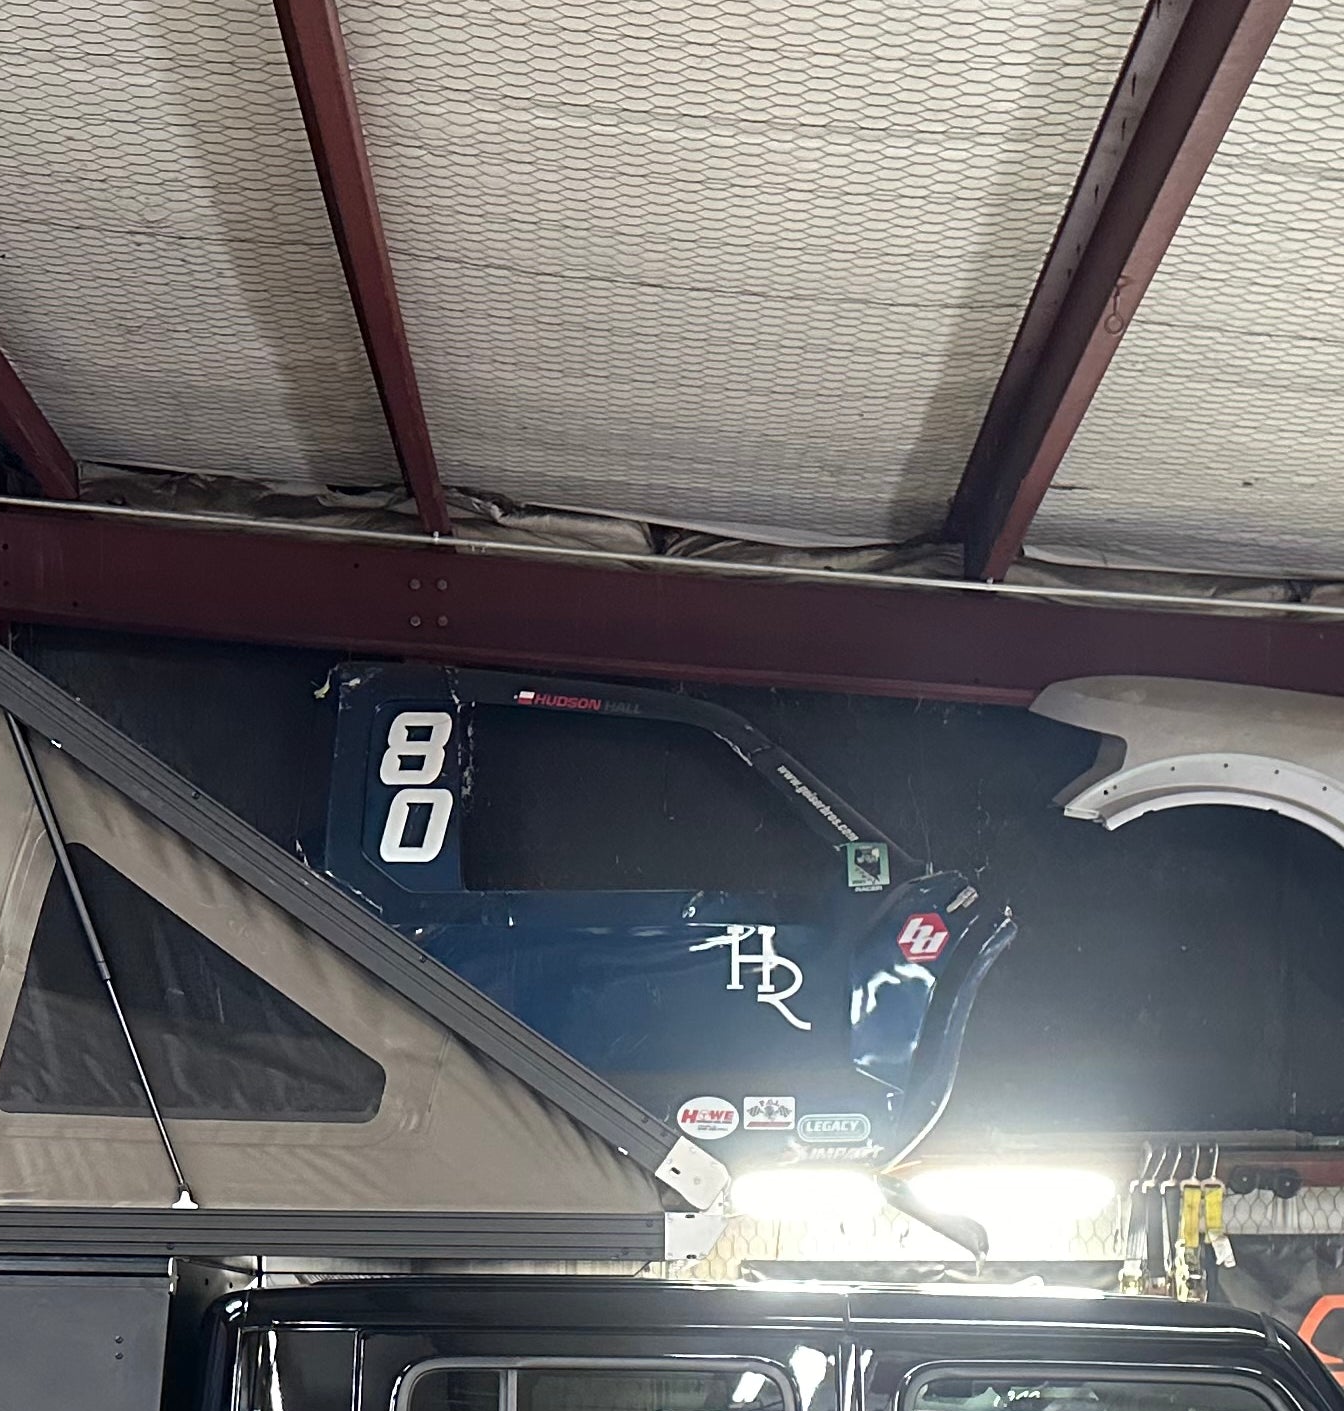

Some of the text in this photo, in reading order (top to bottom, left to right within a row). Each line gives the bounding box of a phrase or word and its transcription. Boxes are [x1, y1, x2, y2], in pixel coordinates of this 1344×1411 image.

[534, 694, 643, 714] HUDSON HALL
[379, 711, 453, 863] 80
[681, 1108, 735, 1124] HOWE
[806, 1120, 860, 1133] LEGACY
